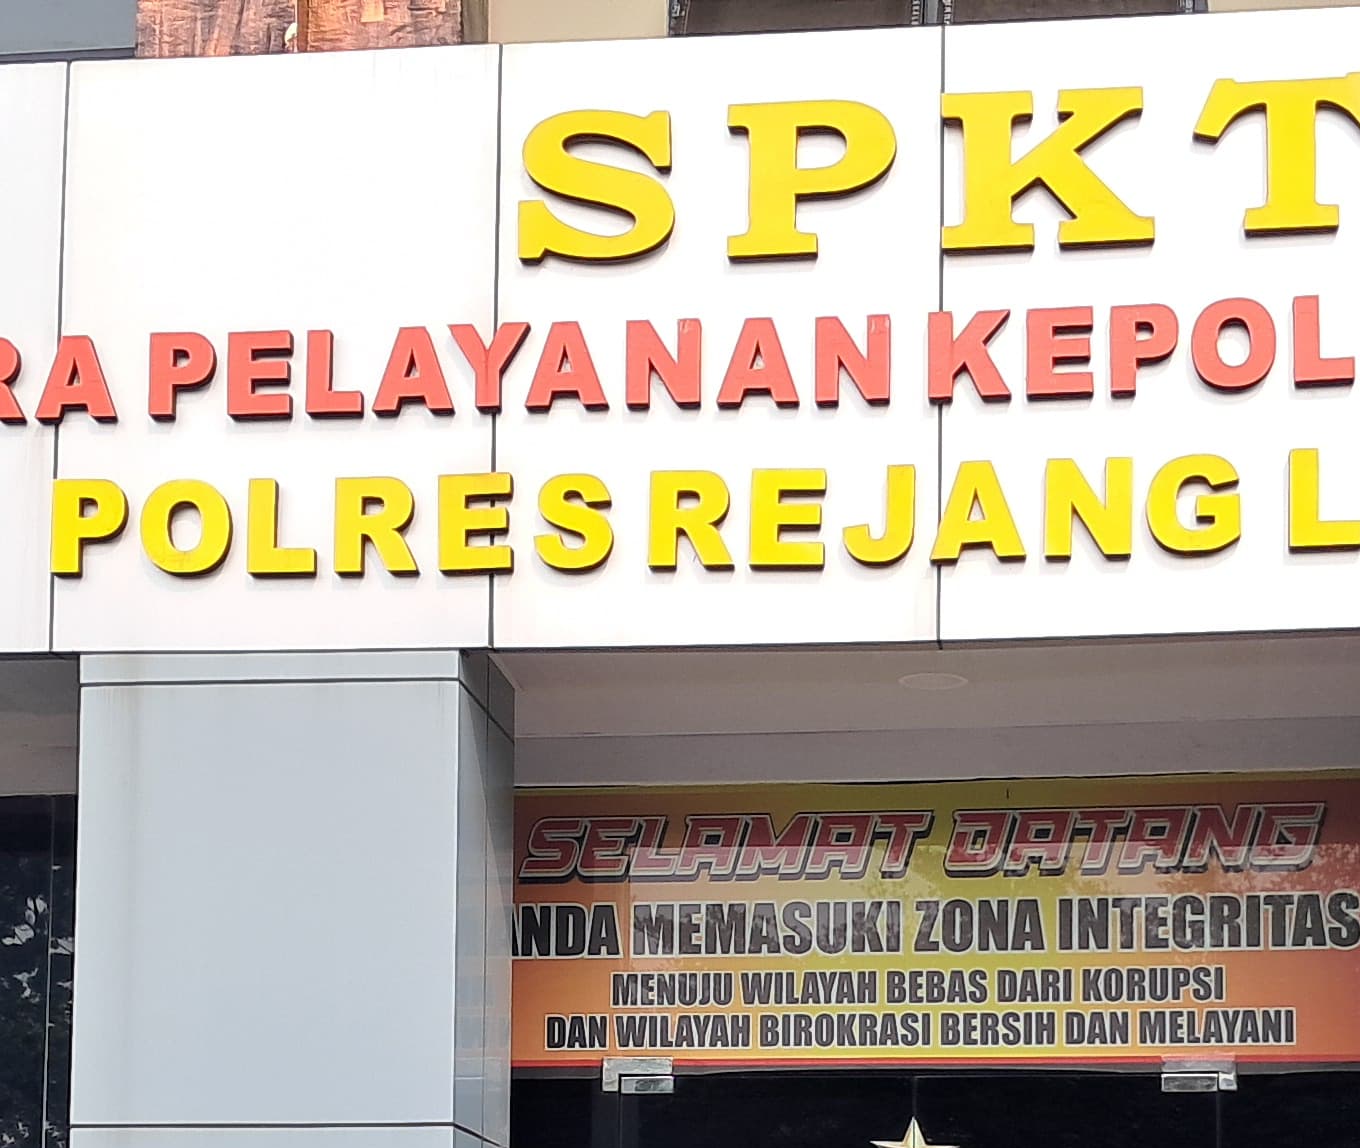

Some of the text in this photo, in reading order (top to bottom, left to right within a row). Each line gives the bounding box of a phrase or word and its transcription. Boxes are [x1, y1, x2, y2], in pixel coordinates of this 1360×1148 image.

[147, 314, 892, 419] PELAYANAN
[51, 472, 615, 577] POLRES
[649, 455, 1242, 570] REJANG
[518, 802, 1327, 882] SELAMAT DATANG
[633, 900, 901, 956] MEMASUKI
[914, 898, 1046, 952] ZONA
[611, 966, 1225, 1006] MENUJU WILAYAH BEBAS DARI KORUPSI
[545, 1008, 1295, 1050] DAN WILAYAH BIROKRASI BERSIH DAN MELAYANI
